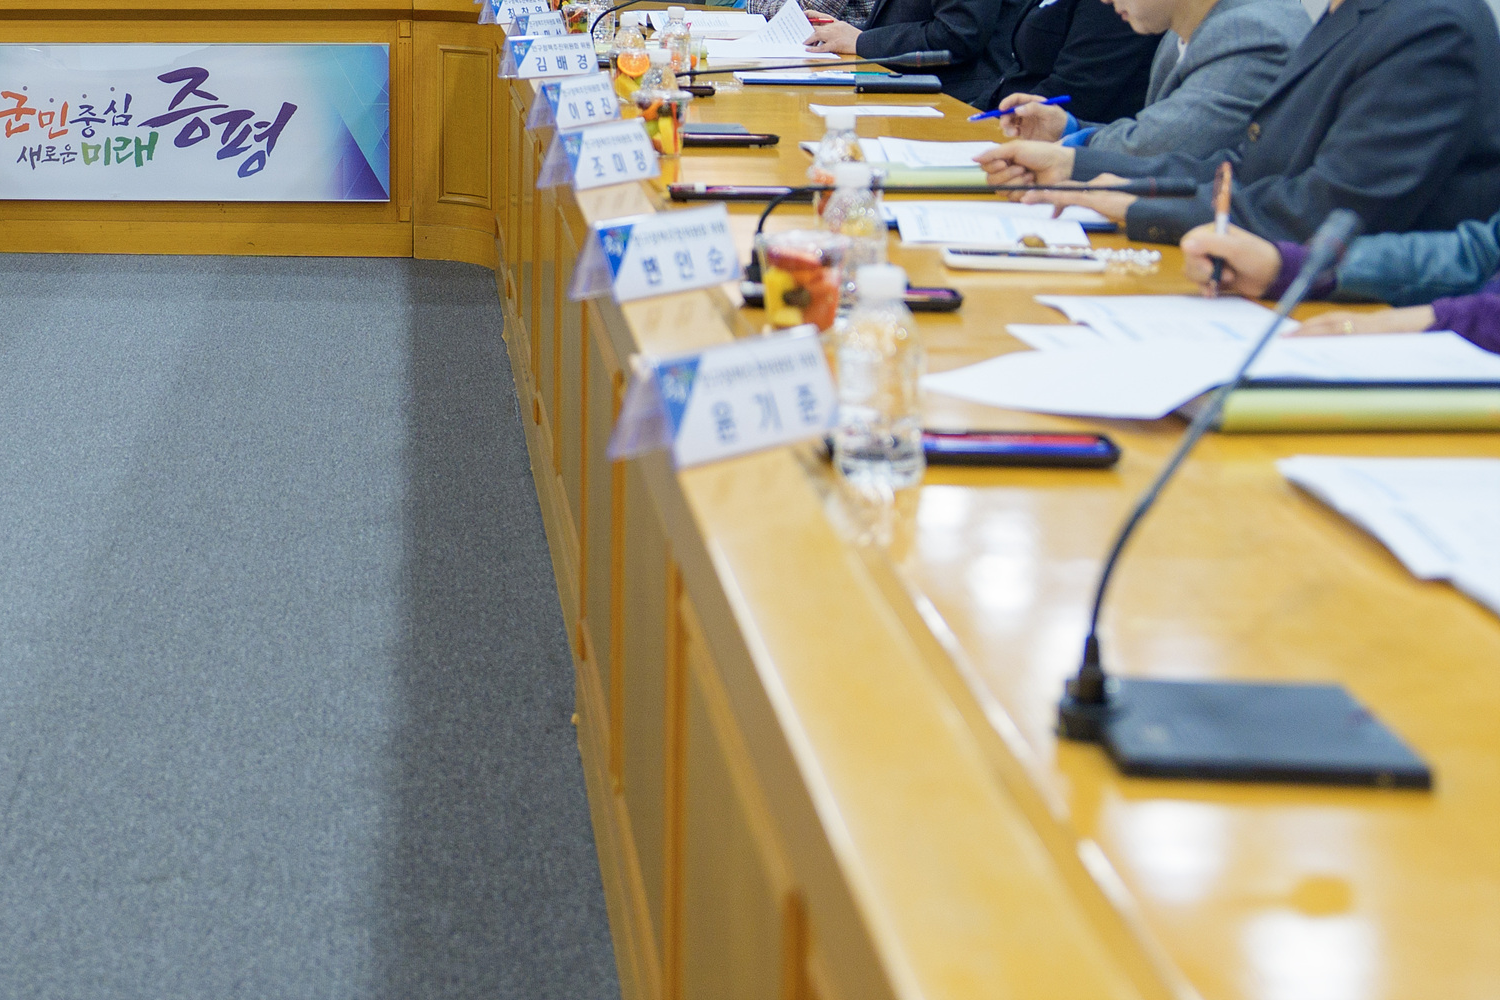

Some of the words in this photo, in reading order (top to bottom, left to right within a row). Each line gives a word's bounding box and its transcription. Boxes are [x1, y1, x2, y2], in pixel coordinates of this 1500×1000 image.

[535, 54, 588, 72] 김배경
[137, 66, 298, 178] 증평
[17, 143, 78, 170] 새로운
[81, 131, 160, 168] 미래
